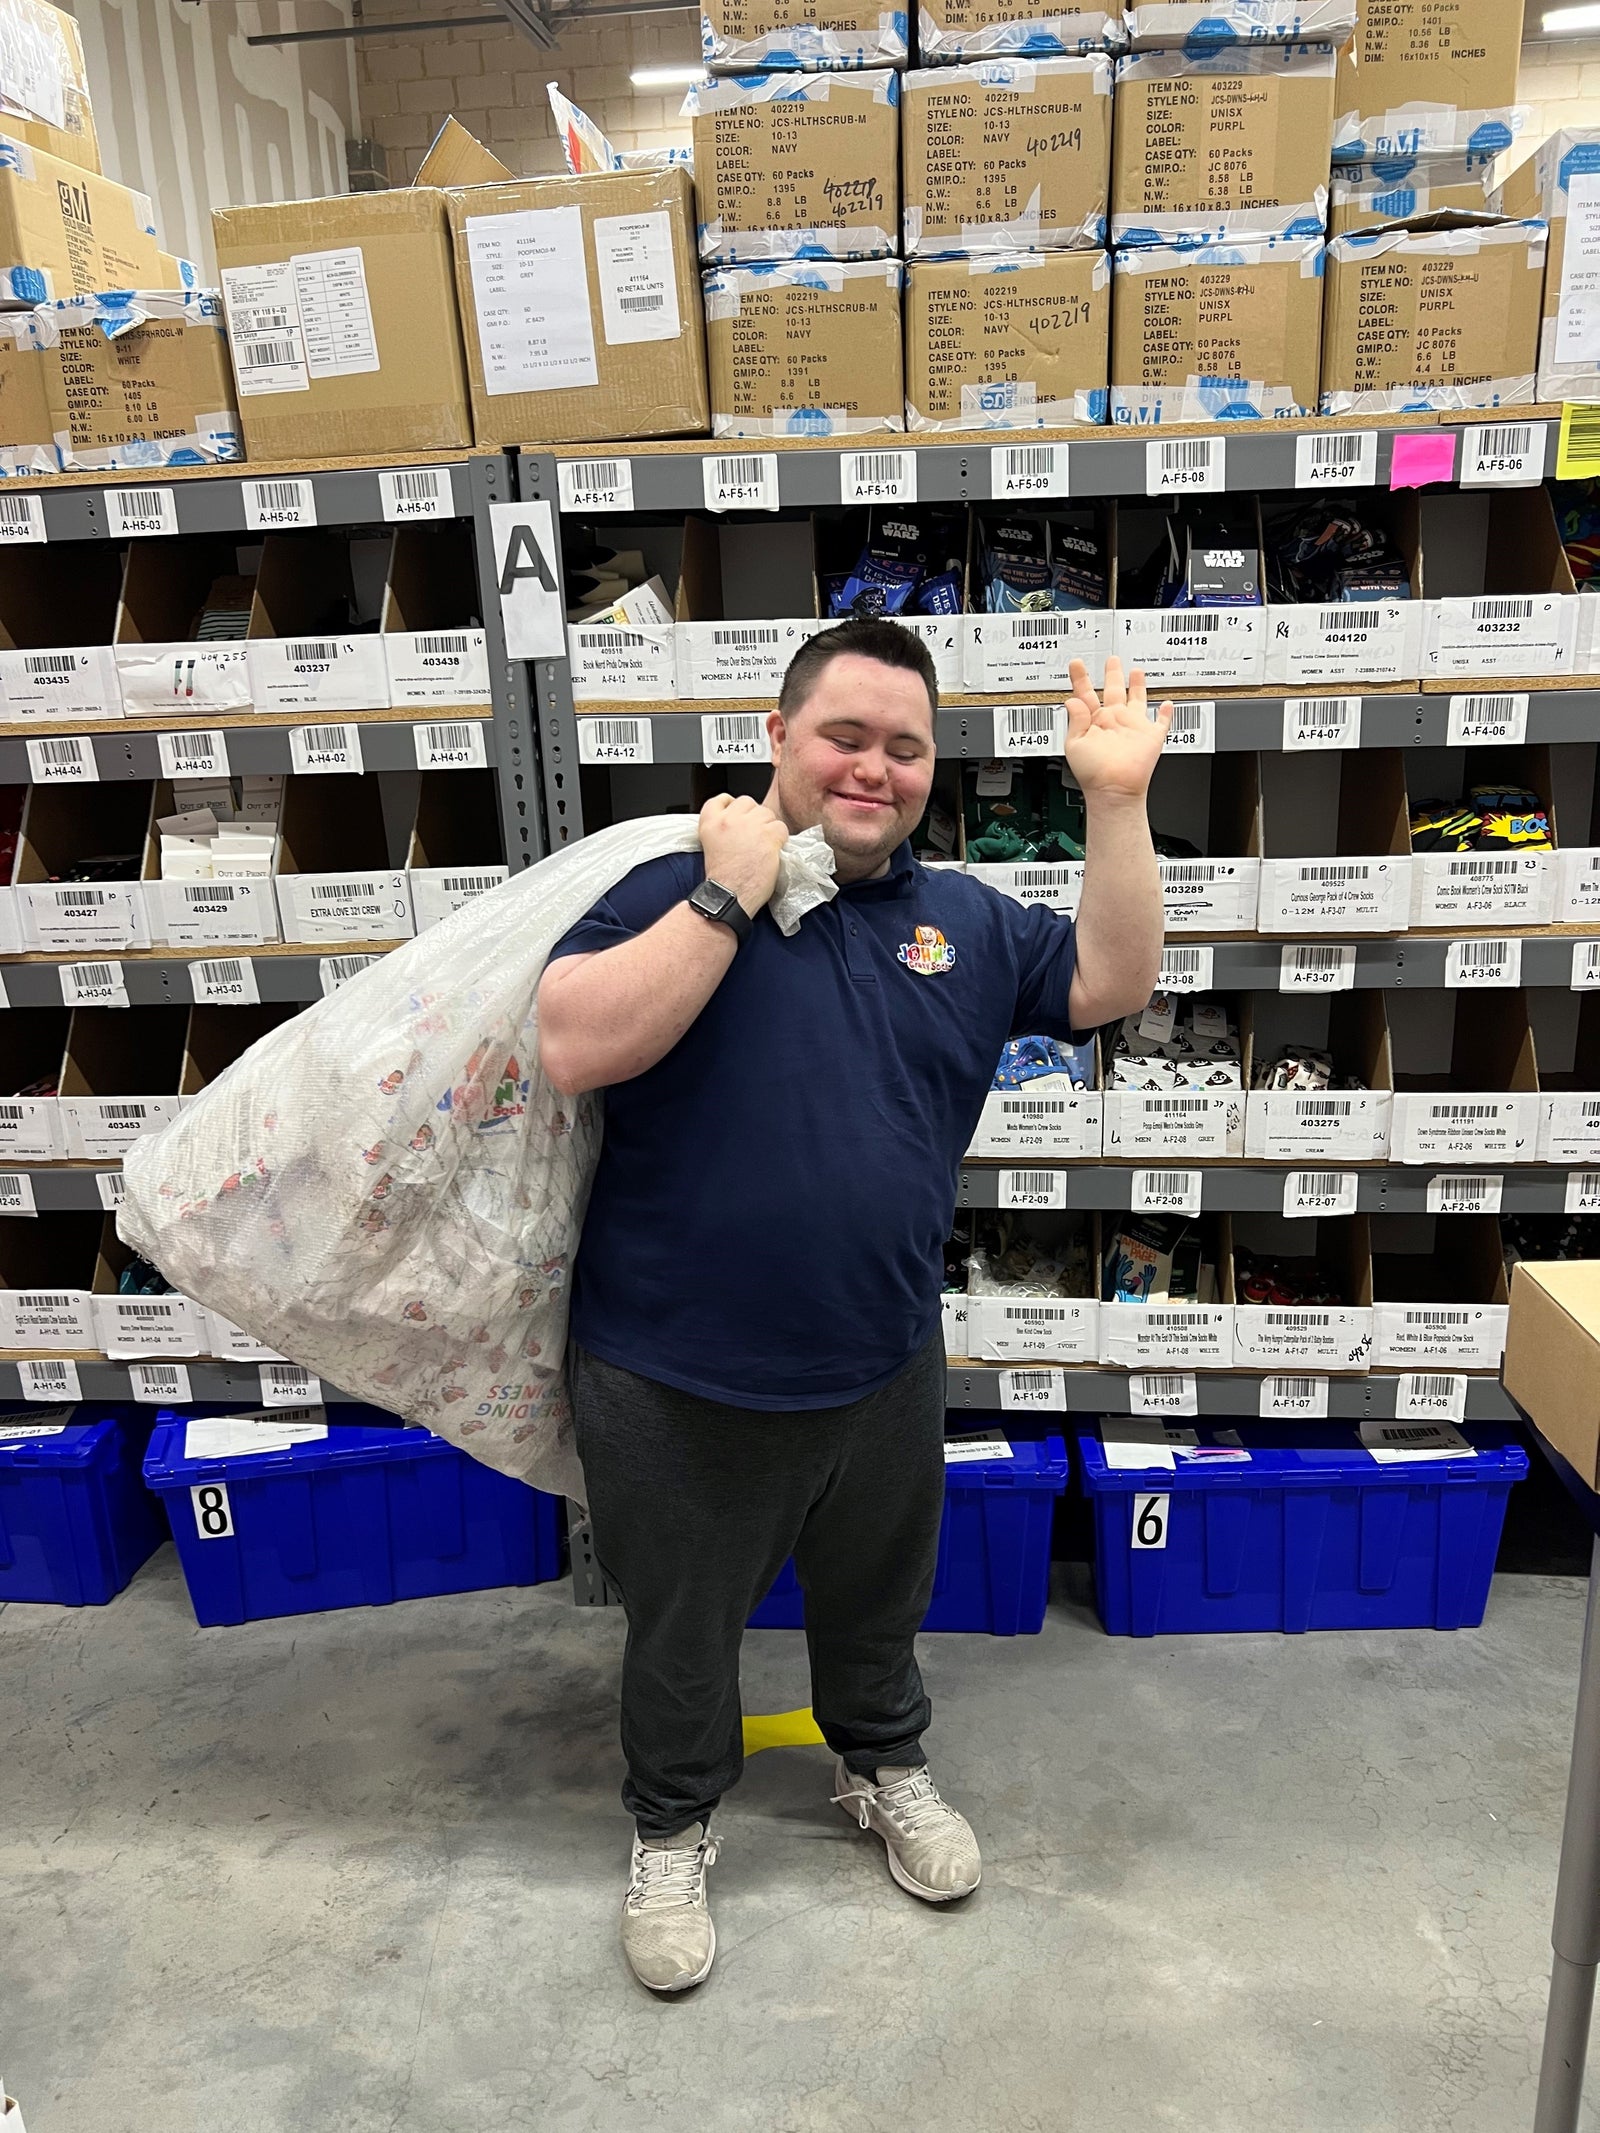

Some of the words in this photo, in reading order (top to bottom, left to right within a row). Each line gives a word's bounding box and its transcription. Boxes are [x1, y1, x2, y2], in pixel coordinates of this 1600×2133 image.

[1368, 6, 1390, 14] CASE
[1394, 5, 1413, 14] QTY:
[1434, 3, 1459, 12] Packs
[1409, 29, 1431, 37] 10.56
[1439, 27, 1450, 35] LB
[1365, 54, 1384, 62] DIM:
[1400, 52, 1439, 61] 16x10x15
[1451, 49, 1486, 59] INCHES
[1212, 81, 1242, 90] 403229
[928, 97, 951, 106] ITEM
[954, 95, 971, 105] NO:
[985, 93, 1019, 102] 402219
[928, 110, 957, 119] STYLE
[960, 108, 977, 117] NO:
[984, 104, 1081, 116] JCS-HLTHSCRUB-M
[1211, 108, 1242, 118] UNISX
[928, 124, 951, 132] SIZE:
[984, 121, 1010, 129] 10-13
[1210, 121, 1245, 131] PURPL
[927, 136, 964, 145] COLOR:
[984, 133, 1010, 143] NAVY
[1027, 128, 1080, 156] 402219
[927, 150, 960, 159] LABEL:
[927, 163, 952, 172] CASE
[956, 161, 976, 171] QTY:
[984, 161, 994, 170] 60
[999, 159, 1026, 169] Packs
[1208, 162, 1221, 172] JC
[1224, 161, 1246, 170] 8076
[984, 175, 1006, 183] 1395
[927, 189, 950, 198] G.W.:
[976, 187, 990, 196] 8.8
[1005, 186, 1016, 194] LB
[926, 202, 949, 211] N.W.:
[976, 200, 990, 209] 6.6
[1005, 199, 1017, 207] LB
[625, 284, 645, 292] RETAIL
[647, 282, 664, 290] UNITS
[1418, 328, 1429, 337] 40
[1432, 327, 1462, 336] Packs
[61, 353, 82, 361] SIZE:
[62, 364, 94, 373] COLOR:
[118, 356, 140, 365] WHITE
[124, 392, 141, 400] 1405
[1477, 459, 1522, 471] A-F5-06
[1311, 466, 1355, 478] A-F5-07
[1161, 471, 1204, 484] A-F5-08
[1007, 478, 1048, 489] A-F5-09
[719, 487, 759, 498] A-F5-11
[856, 485, 897, 496] A-F5-10
[574, 492, 614, 504] A-F5-12
[397, 502, 436, 513] A-H5-01
[260, 512, 299, 522] A-H5-02
[122, 520, 160, 530] A-H5-03
[882, 522, 919, 533] STAR
[0, 526, 29, 536] -H5-04
[883, 528, 919, 540] WARS
[500, 525, 557, 594] A
[1204, 557, 1244, 568] WARS
[1477, 623, 1520, 633] 403232
[1166, 636, 1207, 646] 404118
[1325, 634, 1367, 643] 404120
[1019, 640, 1058, 650] 404121
[423, 657, 459, 666] 403438
[294, 664, 330, 673] 403237
[34, 676, 70, 686] 403435
[1298, 729, 1339, 740] A-F4-07
[1462, 726, 1506, 737] A-F4-06
[1008, 735, 1049, 746] A-F4-09
[1164, 734, 1195, 744] -F4-08
[596, 747, 635, 758] A-F4-12
[717, 744, 755, 754] A-F4-11
[307, 753, 346, 764] A-H4-02
[430, 752, 468, 763] A-H4-01
[176, 760, 212, 770] A-H4-03
[45, 767, 81, 776] A-H4-04
[1021, 890, 1058, 898] 403288
[1165, 885, 1204, 894] 403289
[64, 909, 97, 917] 403427
[193, 905, 227, 913] 403429
[311, 908, 330, 918] EXTRA
[332, 908, 349, 918] LOVE
[362, 906, 380, 916] CREW
[1321, 907, 1345, 915] A-F3-07
[1294, 973, 1334, 983] A-F3-07
[1459, 968, 1501, 979] A-F3-06
[78, 988, 112, 998] A-H3-04
[207, 985, 242, 995] A-H3-03
[108, 1121, 141, 1130] 403453
[1301, 1119, 1340, 1127] 403275
[1011, 1195, 1049, 1205] A-F2-09
[1145, 1196, 1183, 1205] A-F2-08
[1297, 1197, 1336, 1207] A-F2-07
[1440, 1202, 1481, 1212] A-F2-06
[33, 1382, 66, 1391] A-H1-05
[144, 1386, 177, 1395] A-H1-04
[273, 1386, 307, 1396] A-H1-03
[1013, 1391, 1049, 1402] A-F1-09
[1143, 1397, 1180, 1407] A-F1-08
[1273, 1399, 1310, 1408] A-F1-07
[1410, 1398, 1448, 1408] A-F1-06
[199, 1487, 227, 1535] 8
[1137, 1496, 1163, 1546] 6
